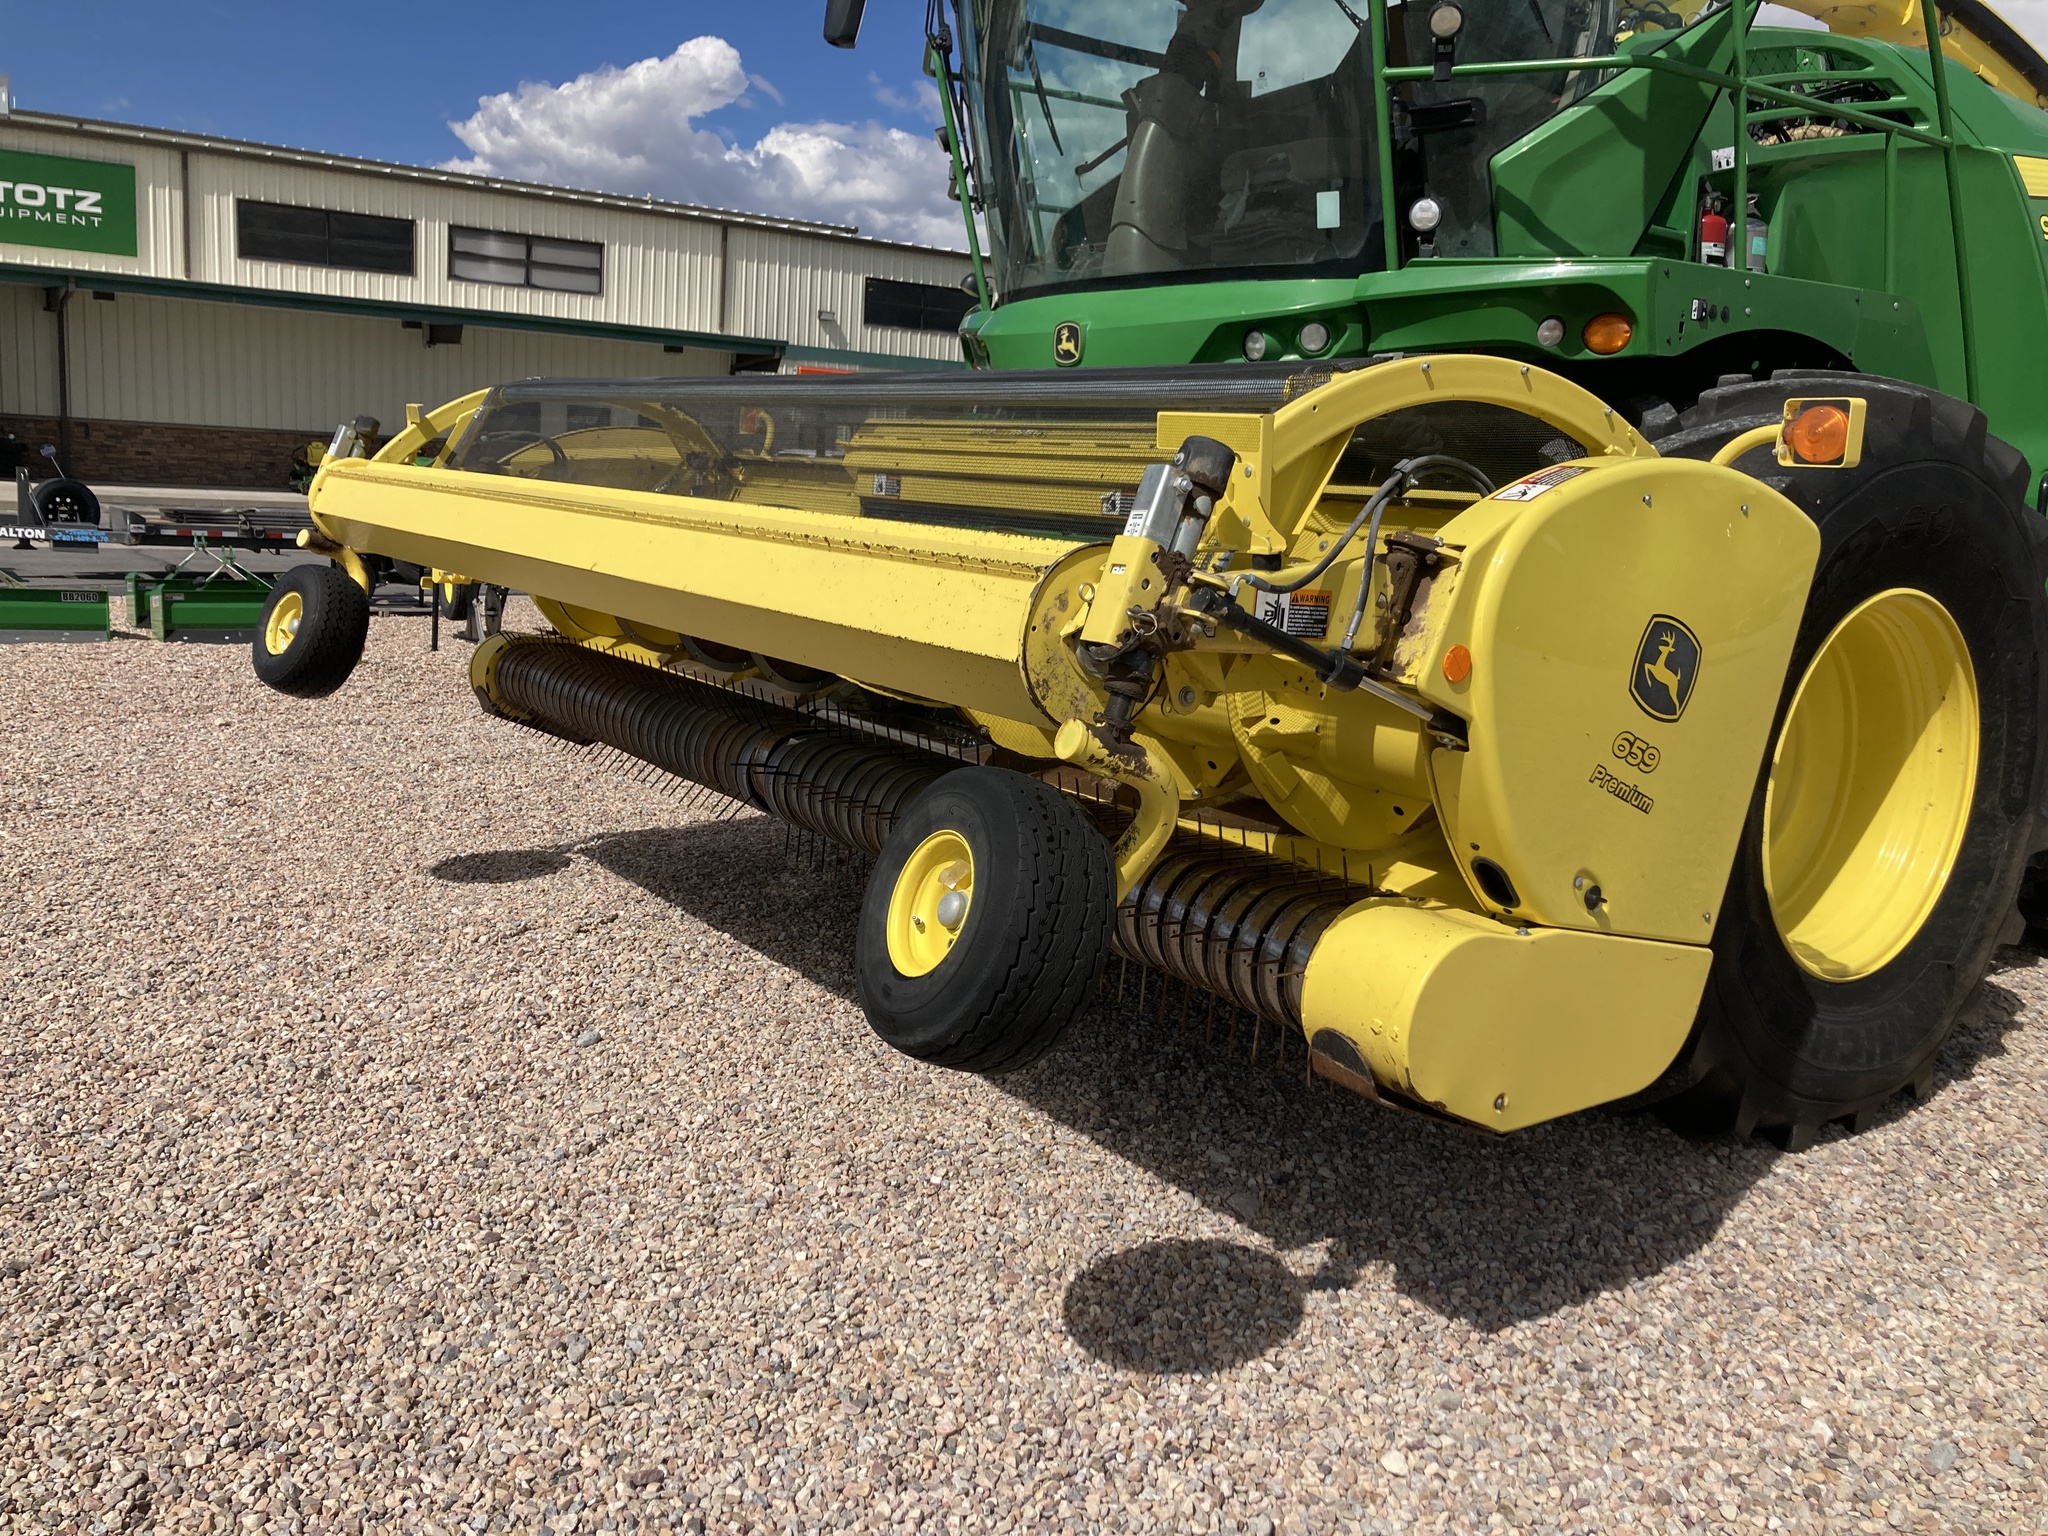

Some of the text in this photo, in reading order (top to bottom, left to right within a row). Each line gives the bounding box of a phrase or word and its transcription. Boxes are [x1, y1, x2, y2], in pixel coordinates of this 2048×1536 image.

[61, 592, 98, 602] BB2060
[1300, 594, 1330, 604] WARNING
[1612, 731, 1661, 774] 659
[1588, 764, 1654, 815] Premium
